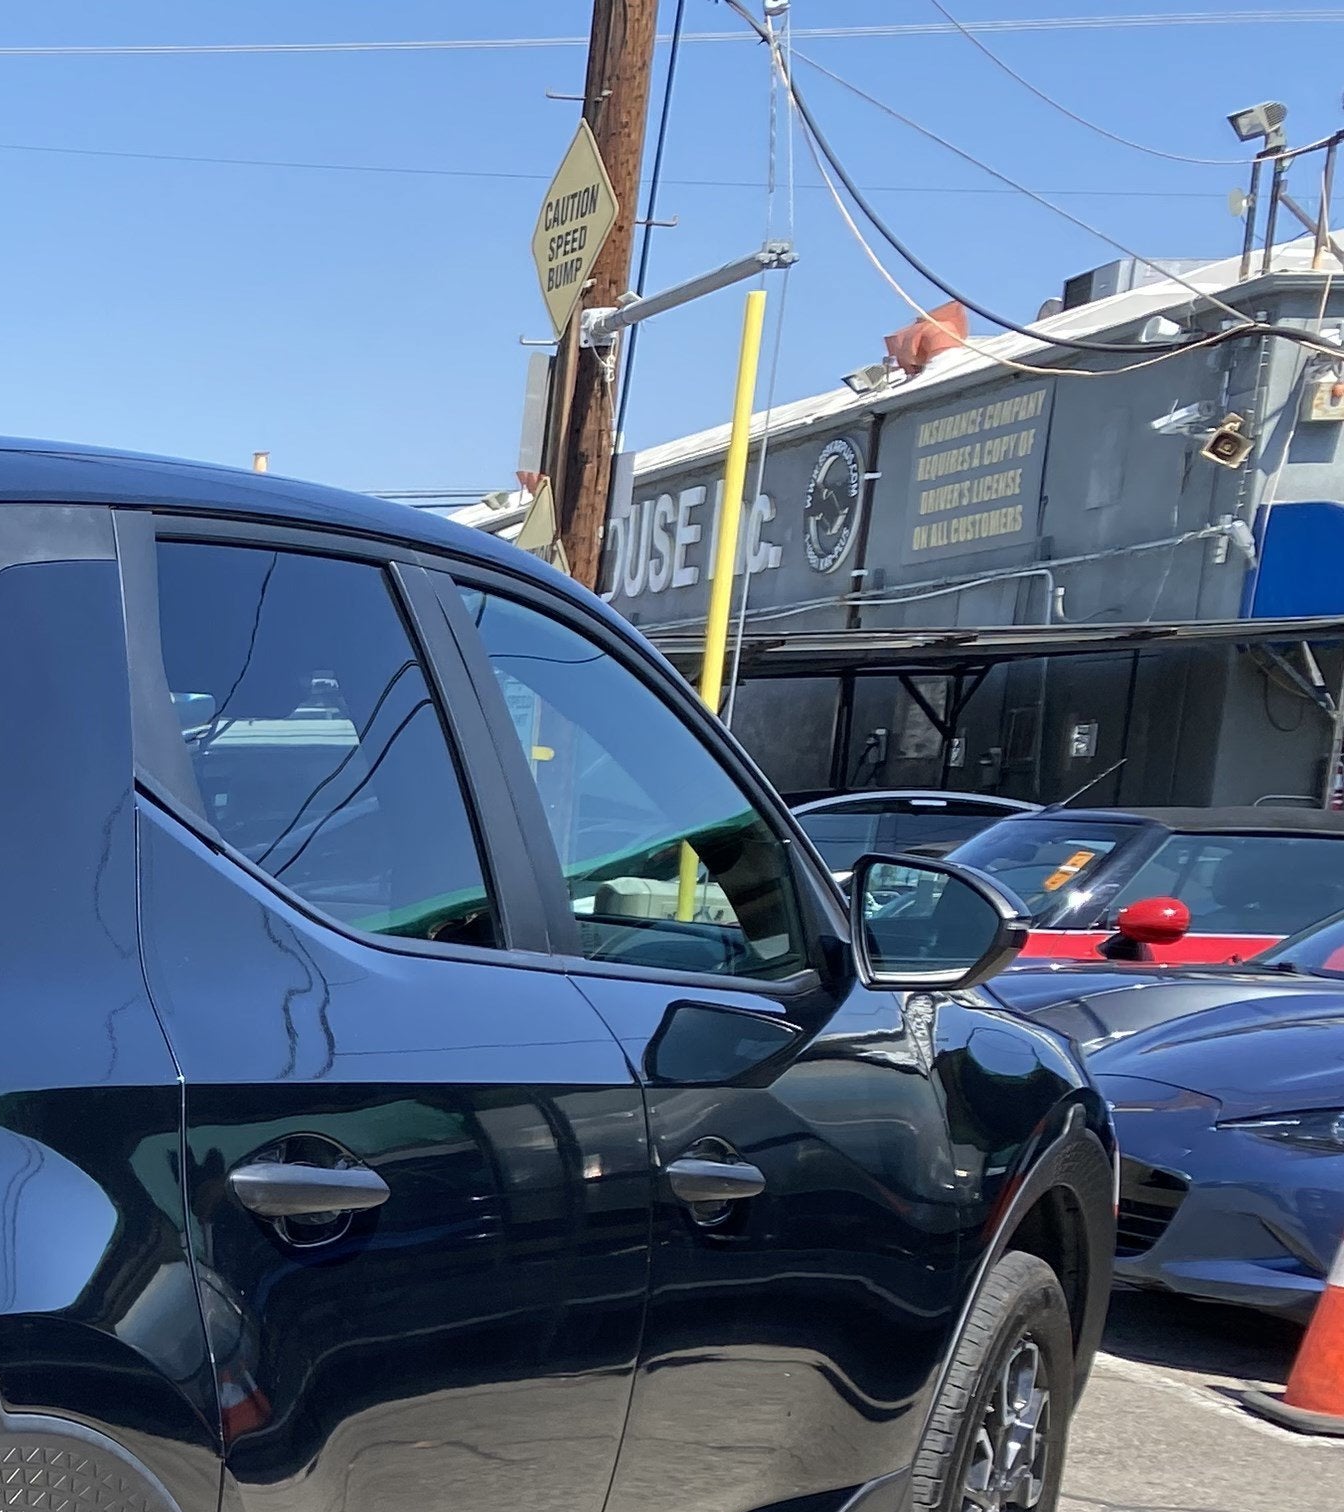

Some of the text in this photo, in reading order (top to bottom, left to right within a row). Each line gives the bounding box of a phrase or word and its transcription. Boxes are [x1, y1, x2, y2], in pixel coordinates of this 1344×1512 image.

[544, 183, 600, 232] CAUTION
[548, 225, 587, 262] SPEED
[547, 257, 582, 292] BUMP
[918, 389, 1047, 448] INSURANCE COMPANY
[916, 428, 1036, 481] REQUIRES A COPY OF
[920, 468, 1023, 515] DRIVER'S LICENSE
[913, 504, 1023, 550] ON ALL CUSTOMERS
